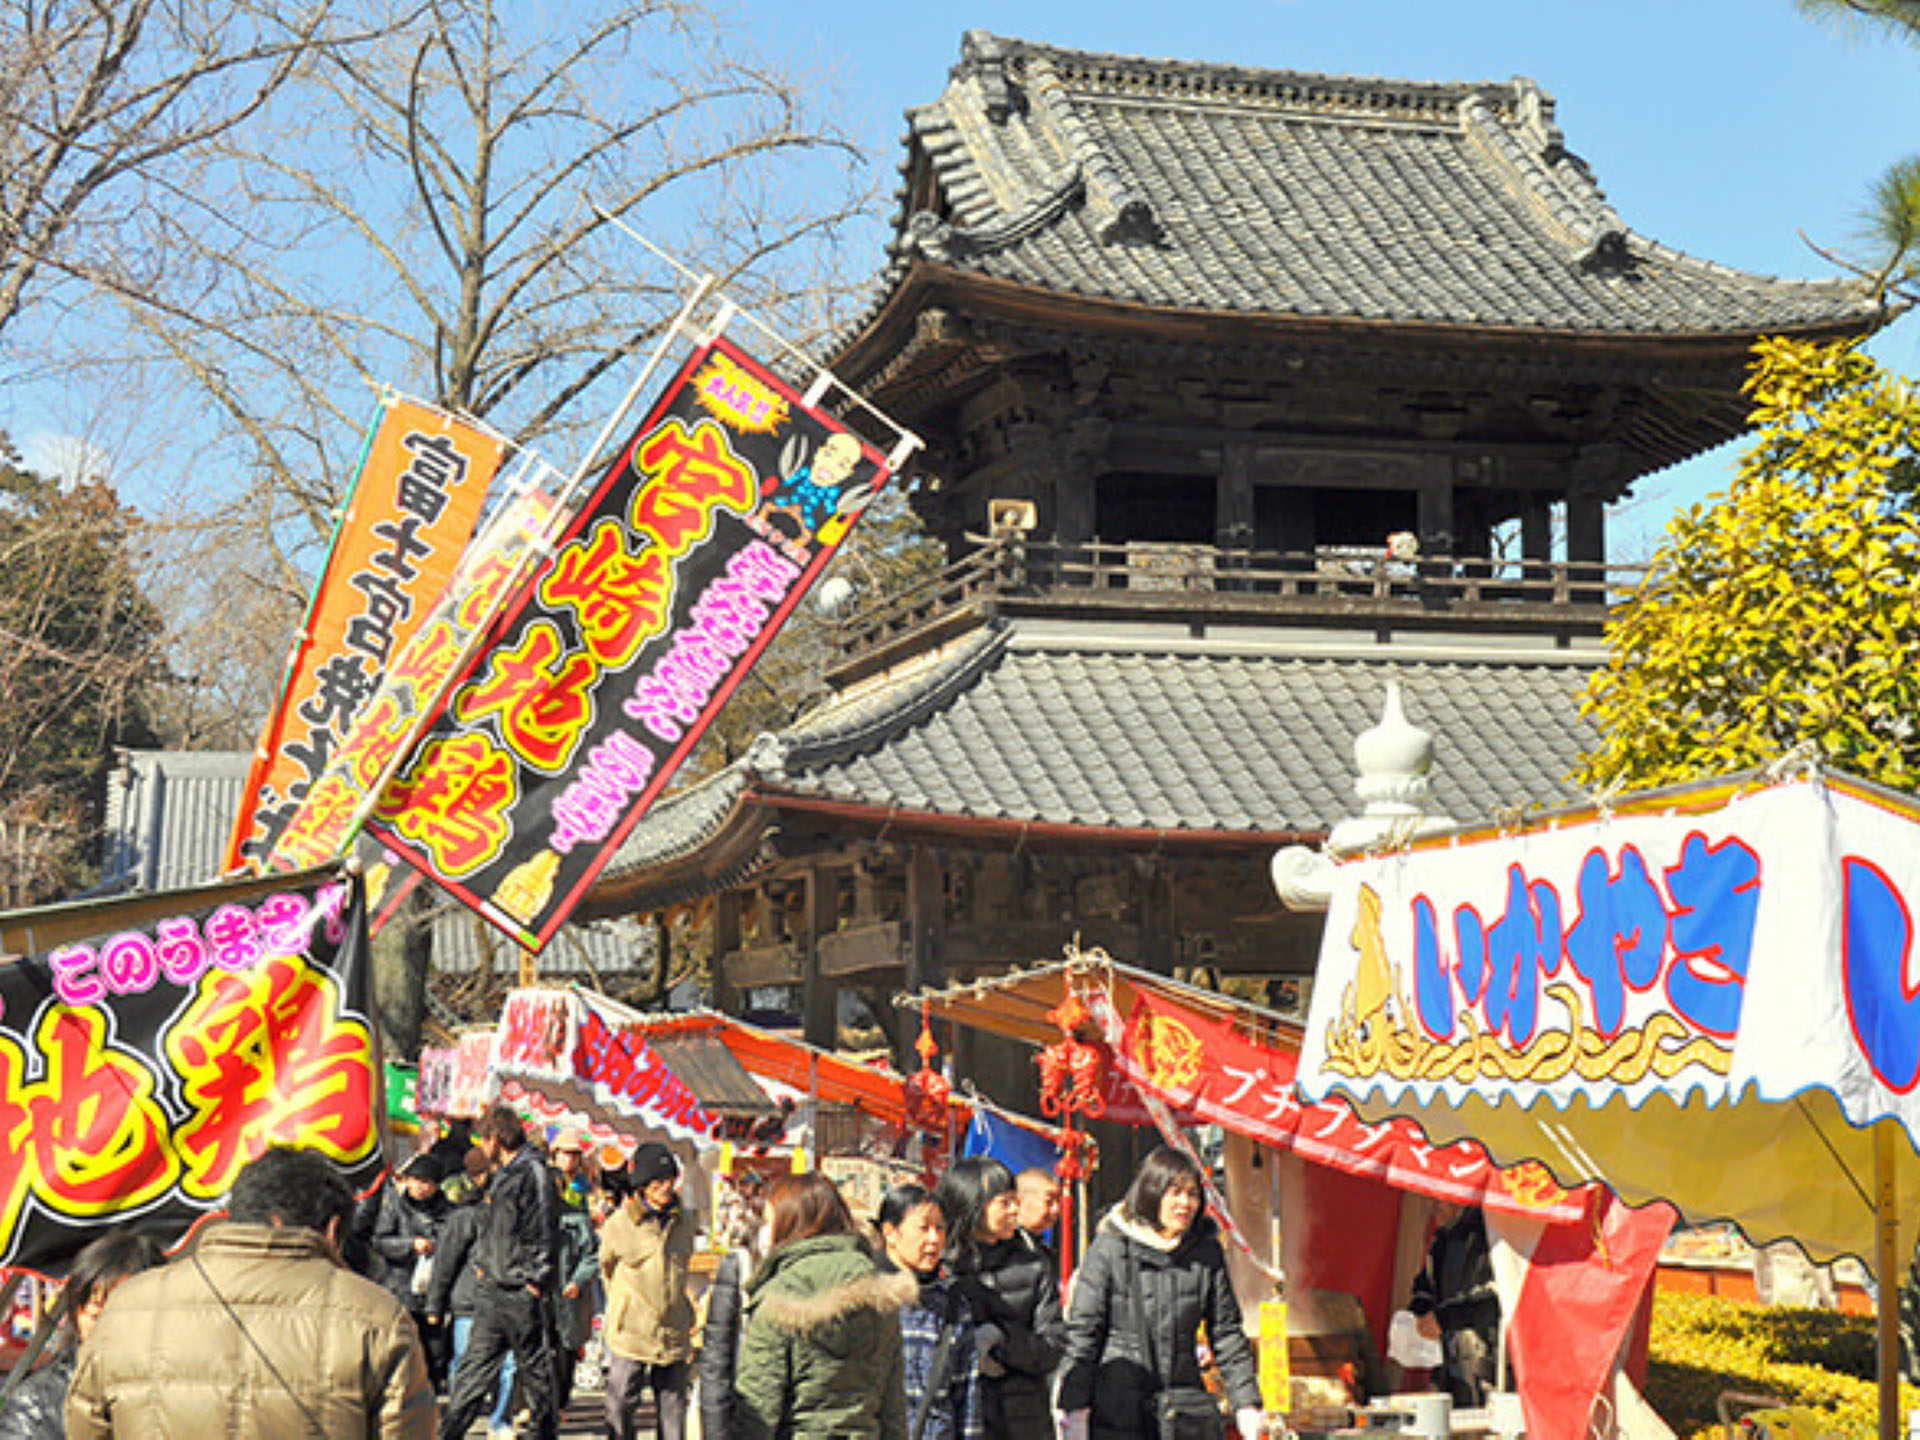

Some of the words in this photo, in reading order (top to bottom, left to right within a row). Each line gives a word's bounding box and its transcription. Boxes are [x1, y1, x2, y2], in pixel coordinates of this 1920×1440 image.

[375, 418, 760, 877] 宮崎地鶏
[1411, 829, 1763, 1051] いかやき
